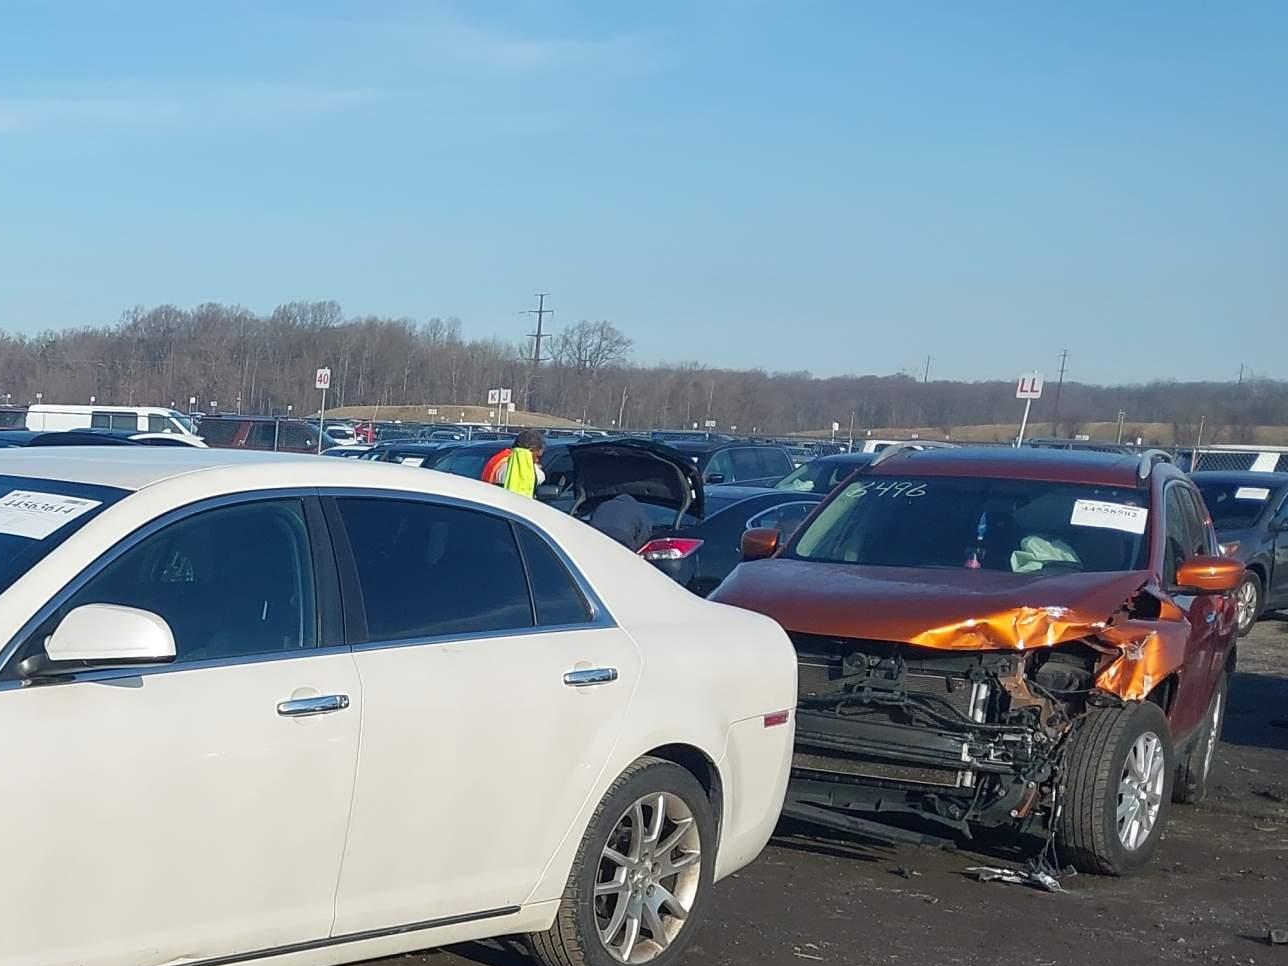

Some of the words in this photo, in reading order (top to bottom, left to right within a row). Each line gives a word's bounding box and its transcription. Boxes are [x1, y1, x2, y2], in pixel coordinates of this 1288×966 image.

[317, 373, 329, 384] 40
[1019, 377, 1040, 393] LL
[490, 391, 497, 401] K
[846, 480, 928, 498] 6496
[2, 499, 77, 515] 44563614
